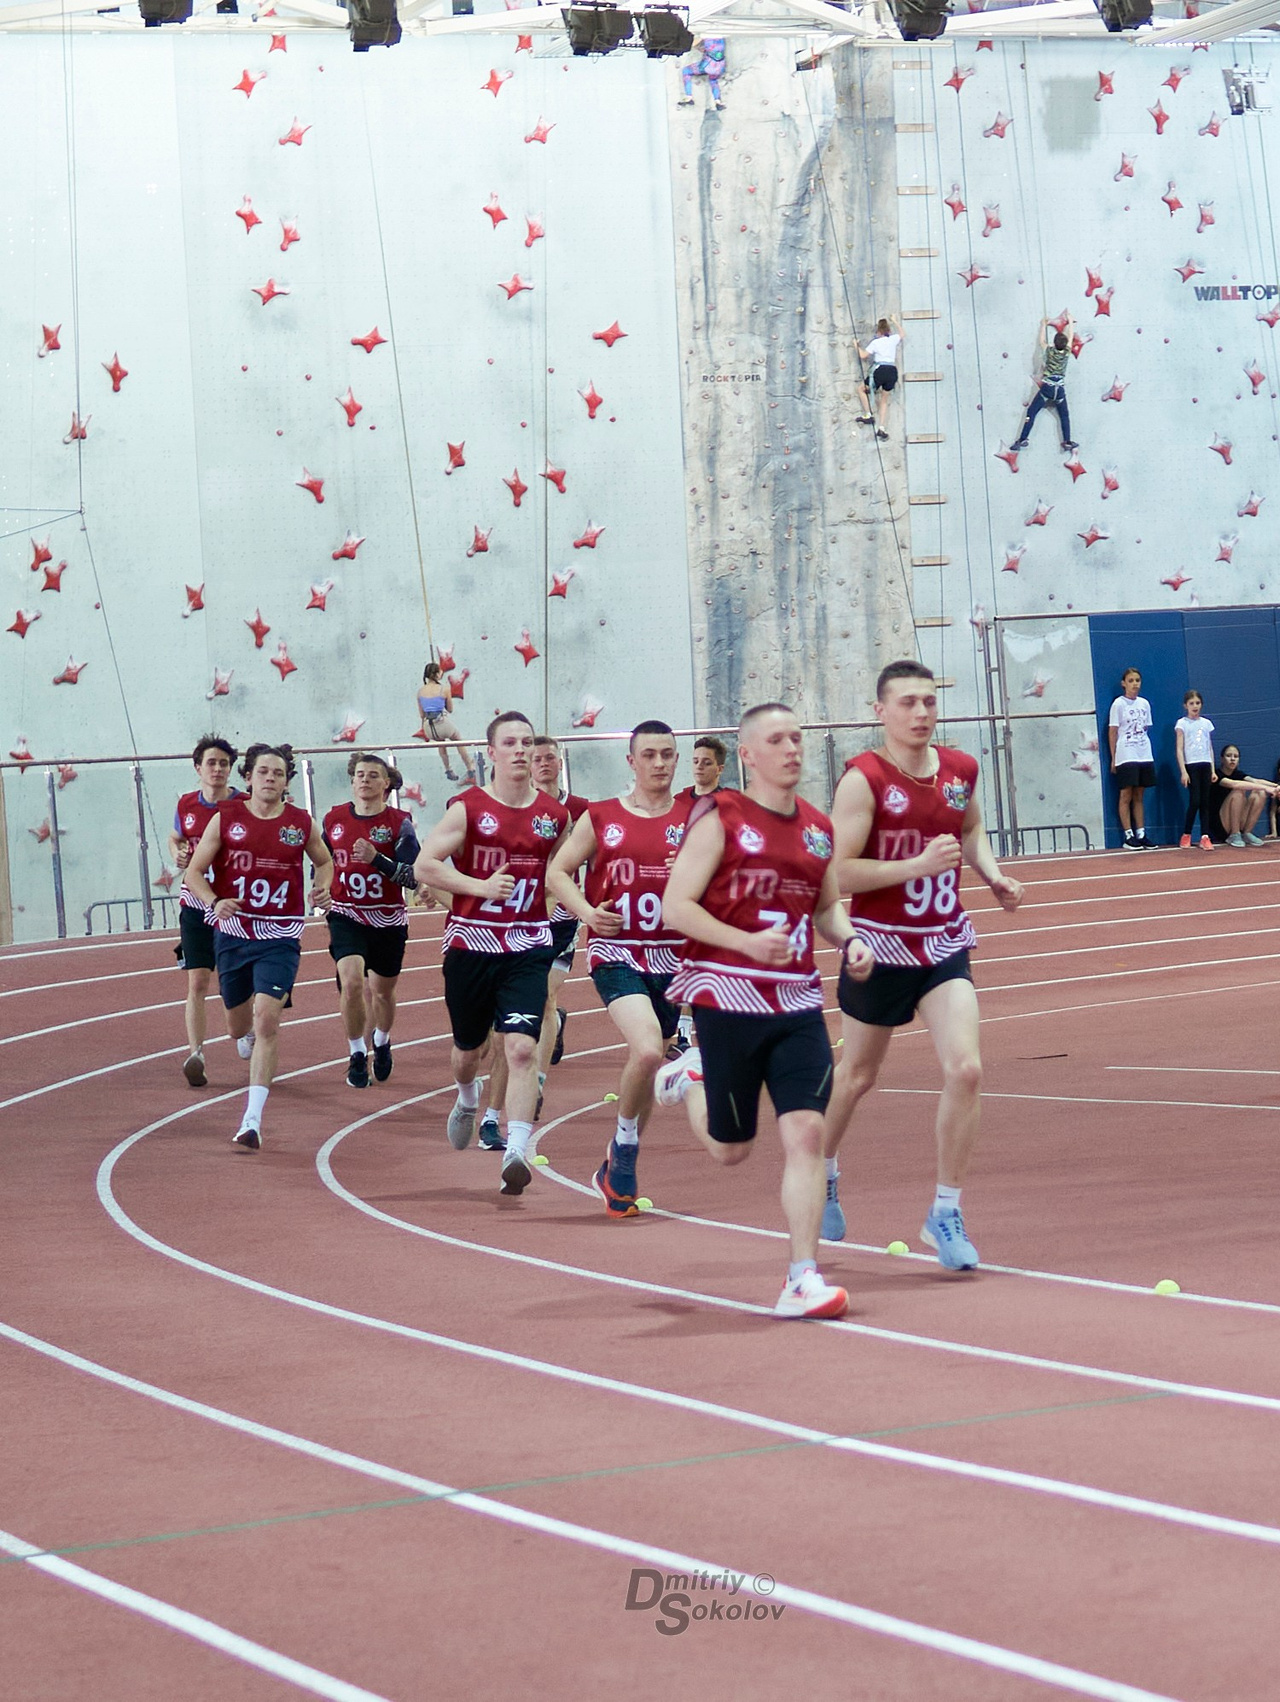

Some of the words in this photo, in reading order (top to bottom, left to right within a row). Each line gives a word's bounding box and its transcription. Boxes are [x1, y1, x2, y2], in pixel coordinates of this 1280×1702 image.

[702, 374, 761, 383] ROCKTOPIA
[232, 875, 290, 909] 194
[615, 892, 670, 932] 19
[904, 868, 957, 917] 98
[758, 909, 809, 961] 74
